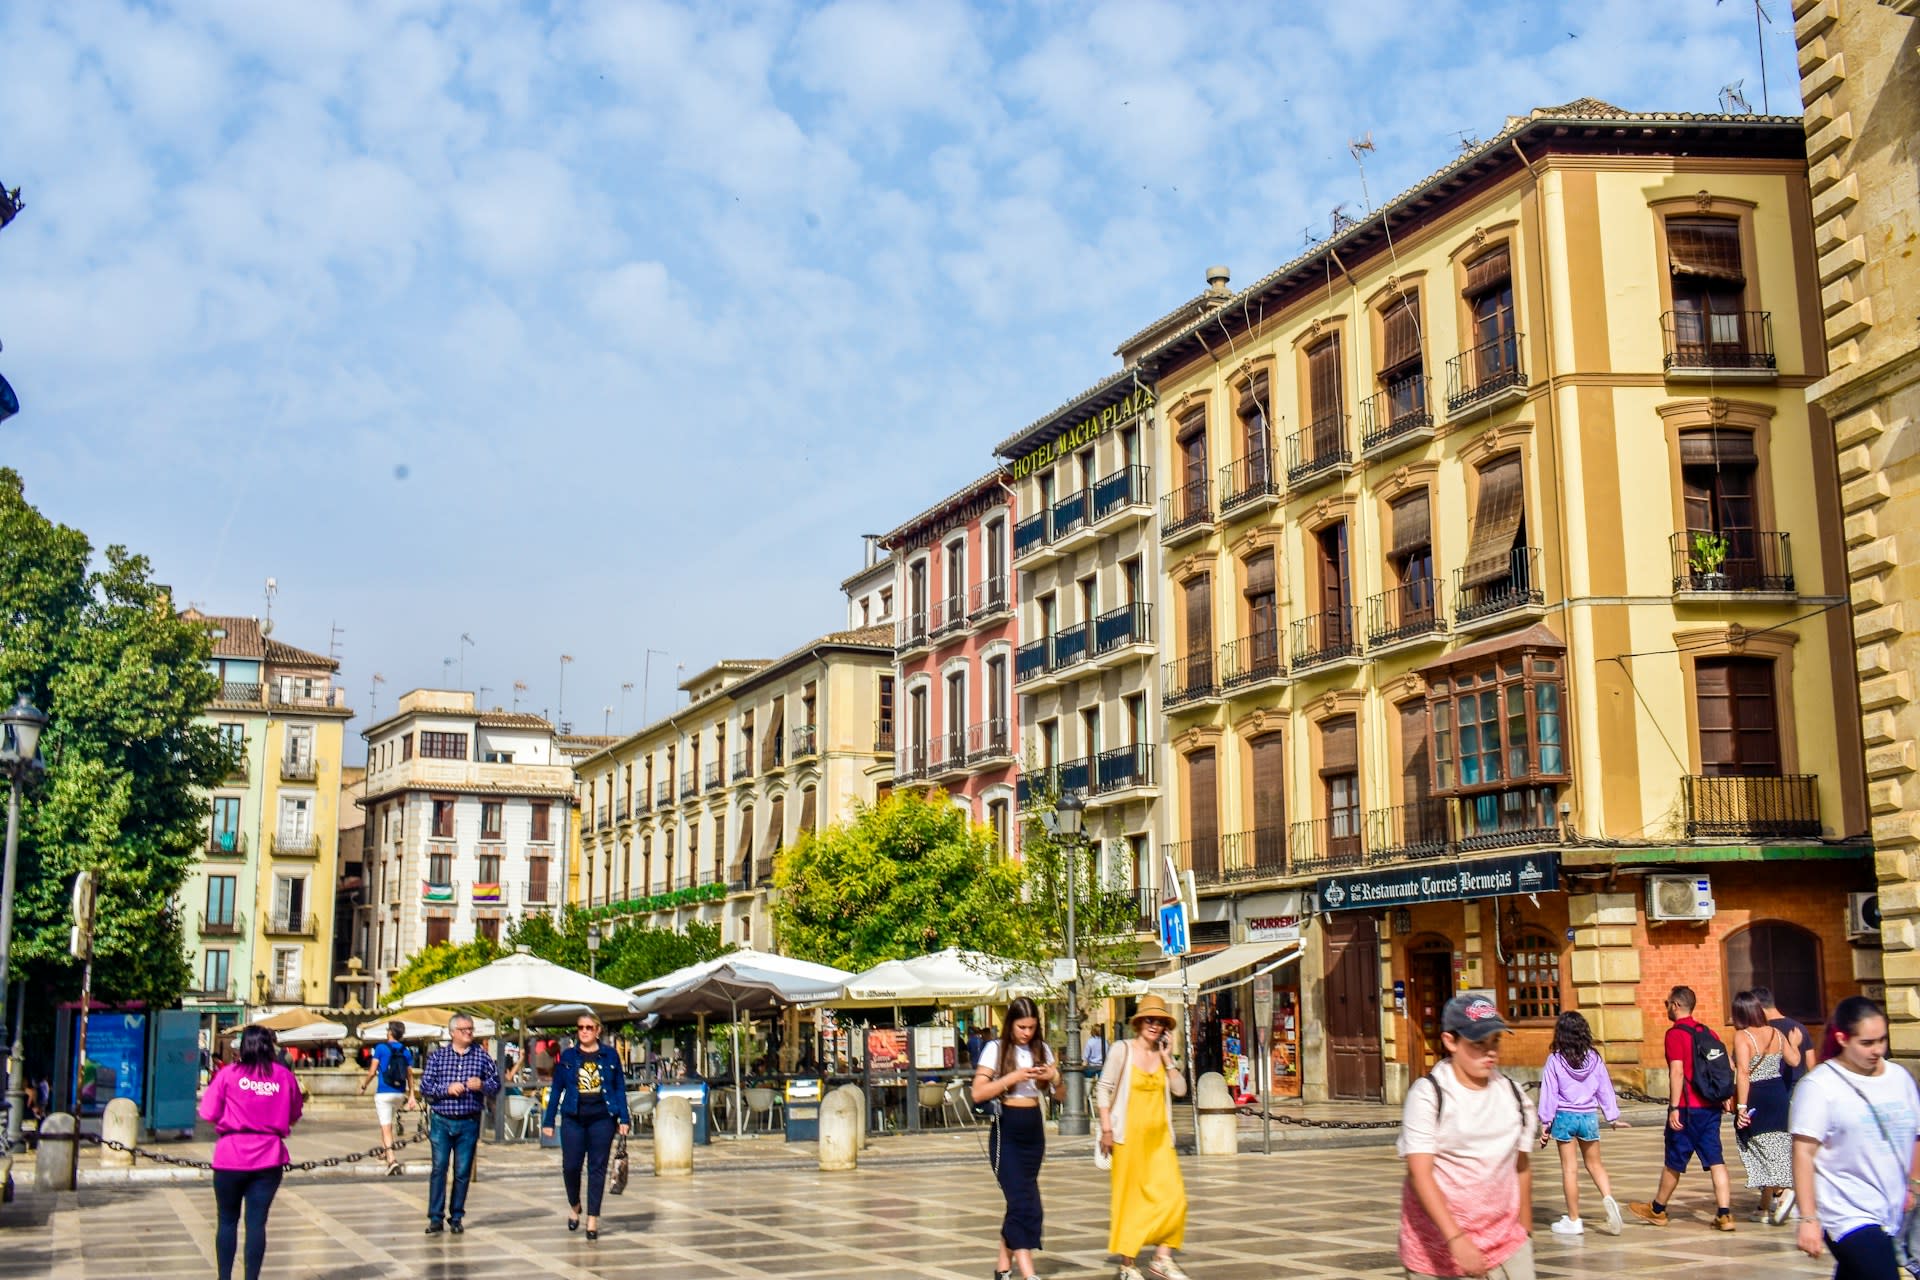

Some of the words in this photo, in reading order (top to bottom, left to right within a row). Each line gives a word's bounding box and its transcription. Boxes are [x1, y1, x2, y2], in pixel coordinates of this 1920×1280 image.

[1014, 442, 1055, 480] HOTEL
[1058, 416, 1099, 455] MACIA
[1102, 385, 1152, 430] PLAZA
[1361, 880, 1419, 901] Restaurante
[1421, 876, 1457, 894] Torres
[1460, 870, 1512, 893] Bermejas
[239, 1077, 279, 1093] ODEON
